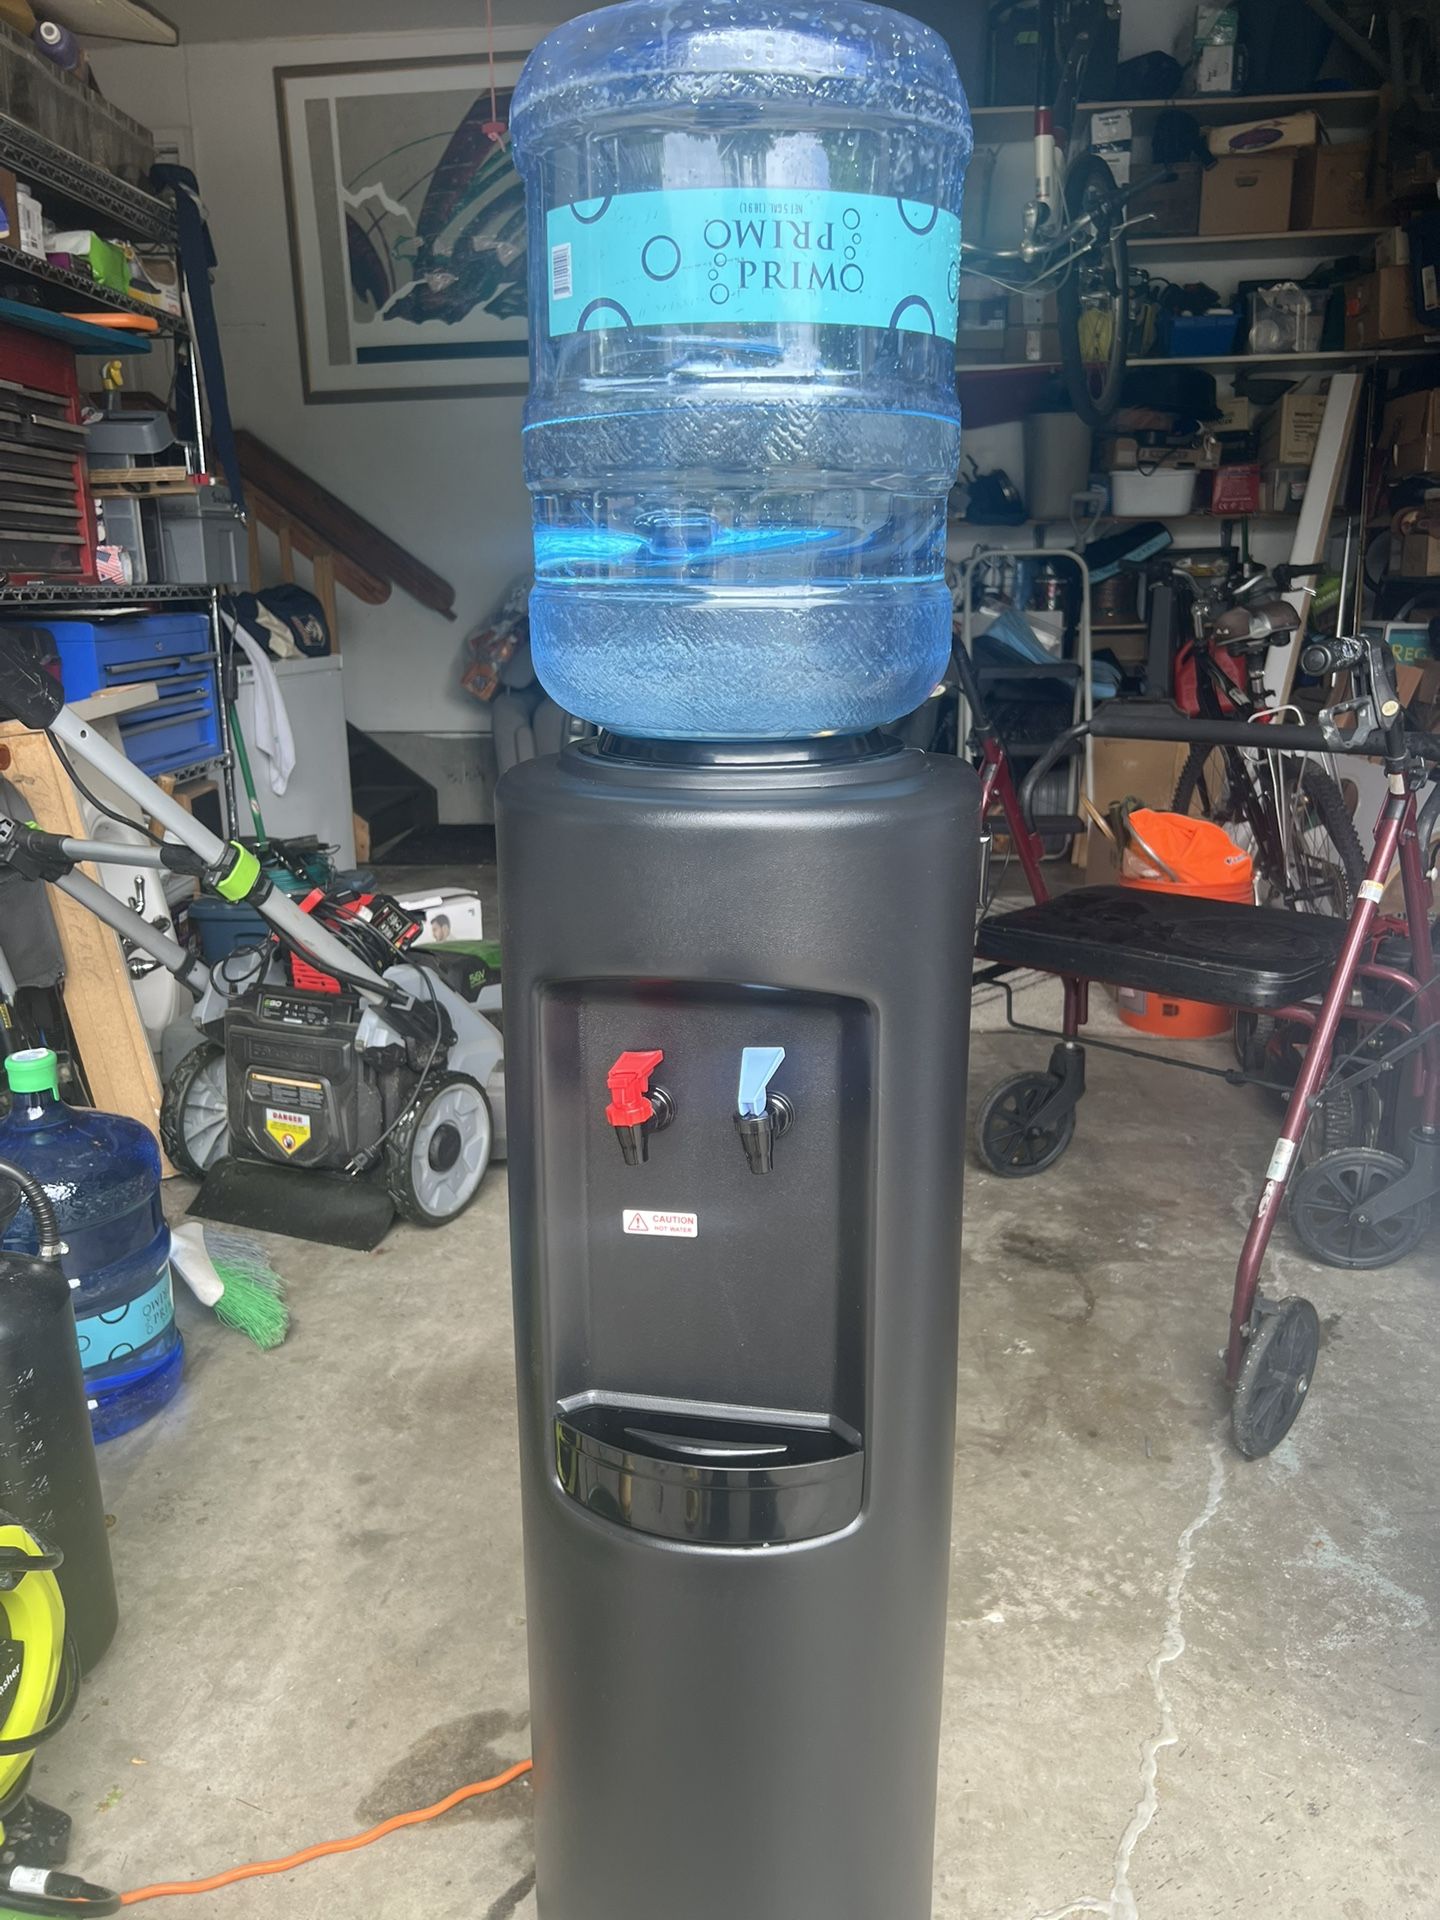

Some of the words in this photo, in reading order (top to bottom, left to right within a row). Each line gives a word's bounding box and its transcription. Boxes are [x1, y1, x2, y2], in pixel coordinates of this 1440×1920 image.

[703, 218, 836, 251] PRIMO
[738, 260, 864, 293] PRIMO
[272, 1111, 303, 1124] DANGER
[652, 1214, 694, 1225] CAUTION
